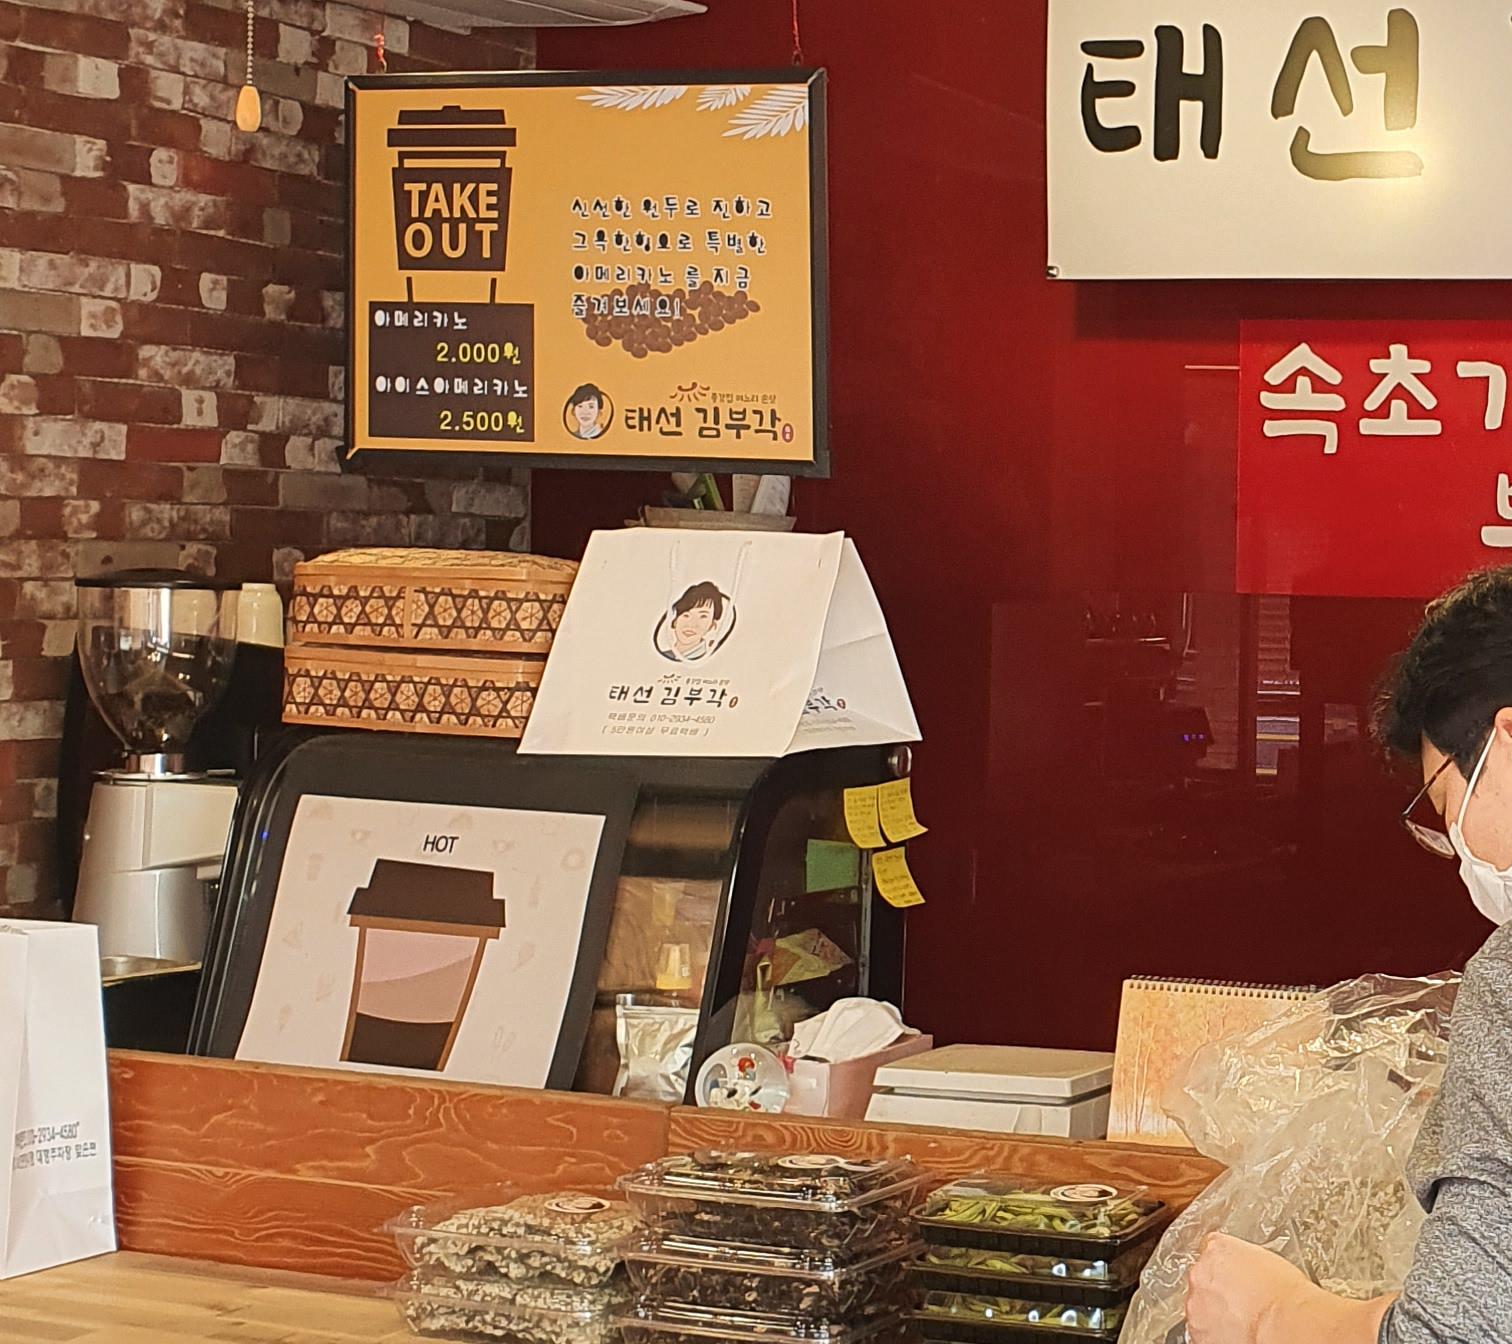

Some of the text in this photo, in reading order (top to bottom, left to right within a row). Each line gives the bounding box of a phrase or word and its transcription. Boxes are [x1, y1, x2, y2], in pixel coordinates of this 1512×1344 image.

[1079, 7, 1423, 182] 태선
[404, 182, 499, 219] TAKE
[572, 196, 771, 220] 신선한 원두로 진하고
[404, 222, 499, 259] OUT
[706, 230, 766, 254] 특별한
[713, 266, 750, 289] 지금
[572, 293, 681, 319] 즐겨보세요!
[374, 309, 468, 330] 아메리카노
[375, 375, 528, 398] 아이스아메리카노
[624, 406, 683, 437] 태선
[694, 406, 781, 441] 김부각
[608, 685, 728, 708] 태선 김부각
[423, 834, 460, 854] HOT
